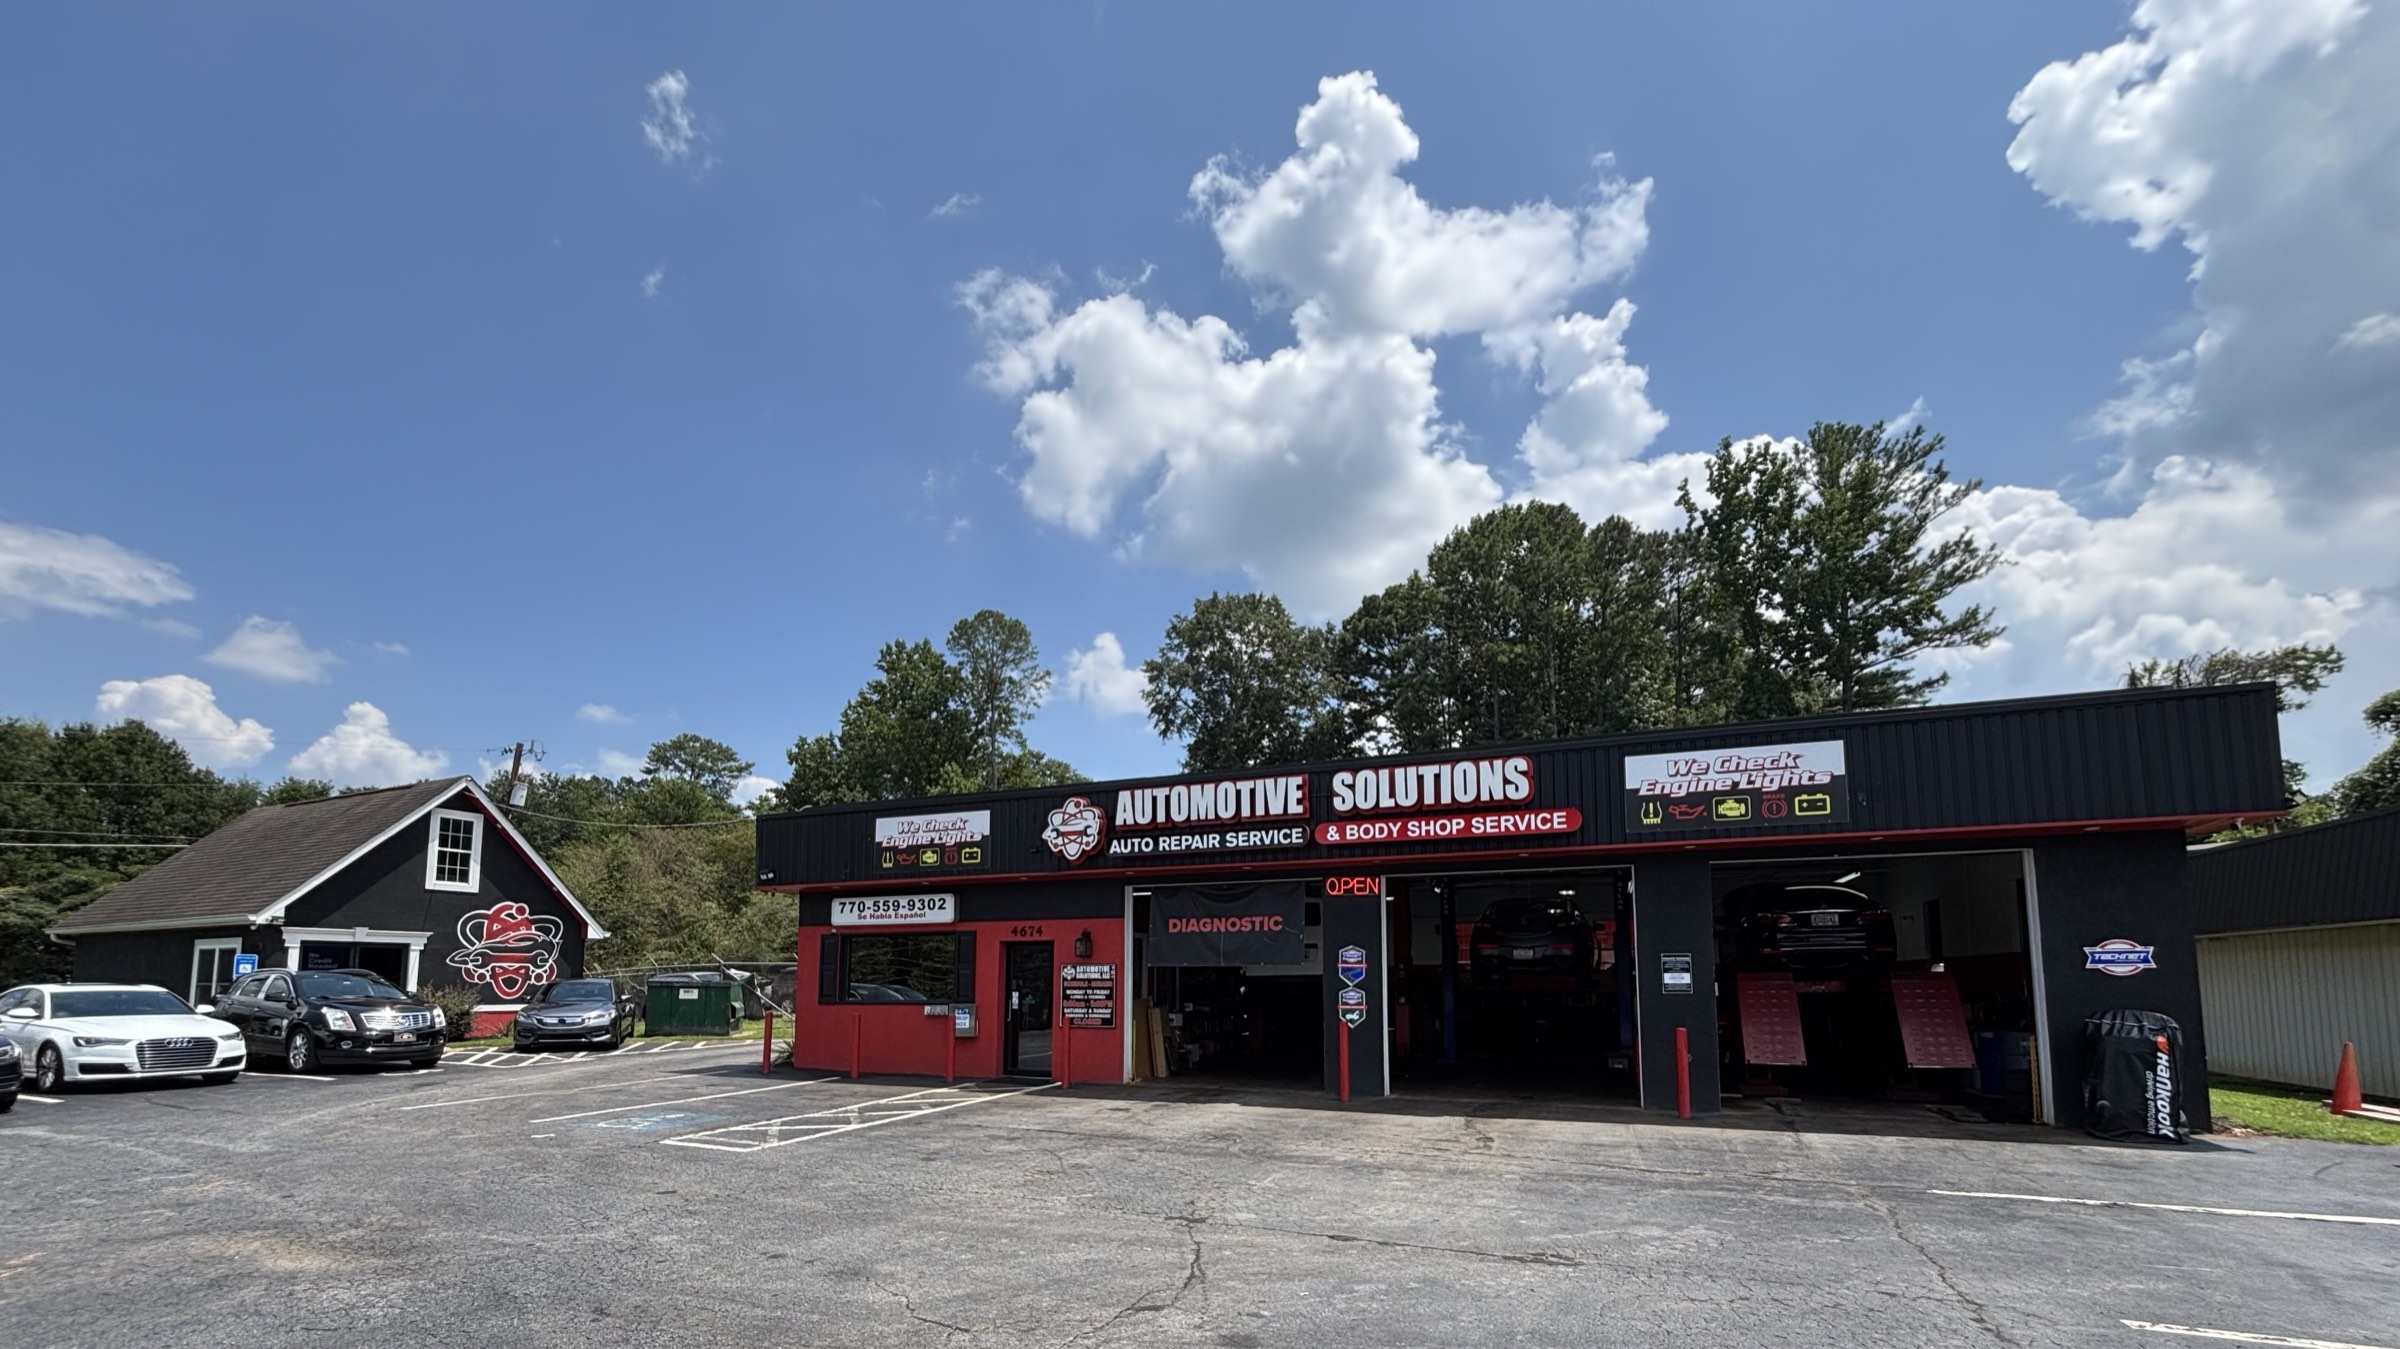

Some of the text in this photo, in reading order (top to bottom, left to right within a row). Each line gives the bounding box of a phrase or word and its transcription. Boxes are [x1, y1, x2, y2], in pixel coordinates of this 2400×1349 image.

[1667, 751, 1803, 777] We Check
[1332, 757, 1530, 812] SOLUTIONS
[1638, 770, 1833, 797] Engine Lights
[1115, 776, 1304, 826] AUTOMOTIVE
[898, 818, 968, 834] We Check
[1326, 812, 1567, 841] & BODY SHOP SERVICE
[881, 831, 984, 849] Engine Lights
[1109, 828, 1304, 854] AUTO REPAIR SERVICE
[1326, 877, 1379, 896] OPEN
[838, 898, 947, 914] 770-559-9302
[869, 912, 892, 920] Habla
[894, 911, 926, 920] Español
[1011, 925, 1043, 937] 4674
[1168, 915, 1284, 933] DIAGNOSTIC
[2145, 1070, 2156, 1135] driving emotion
